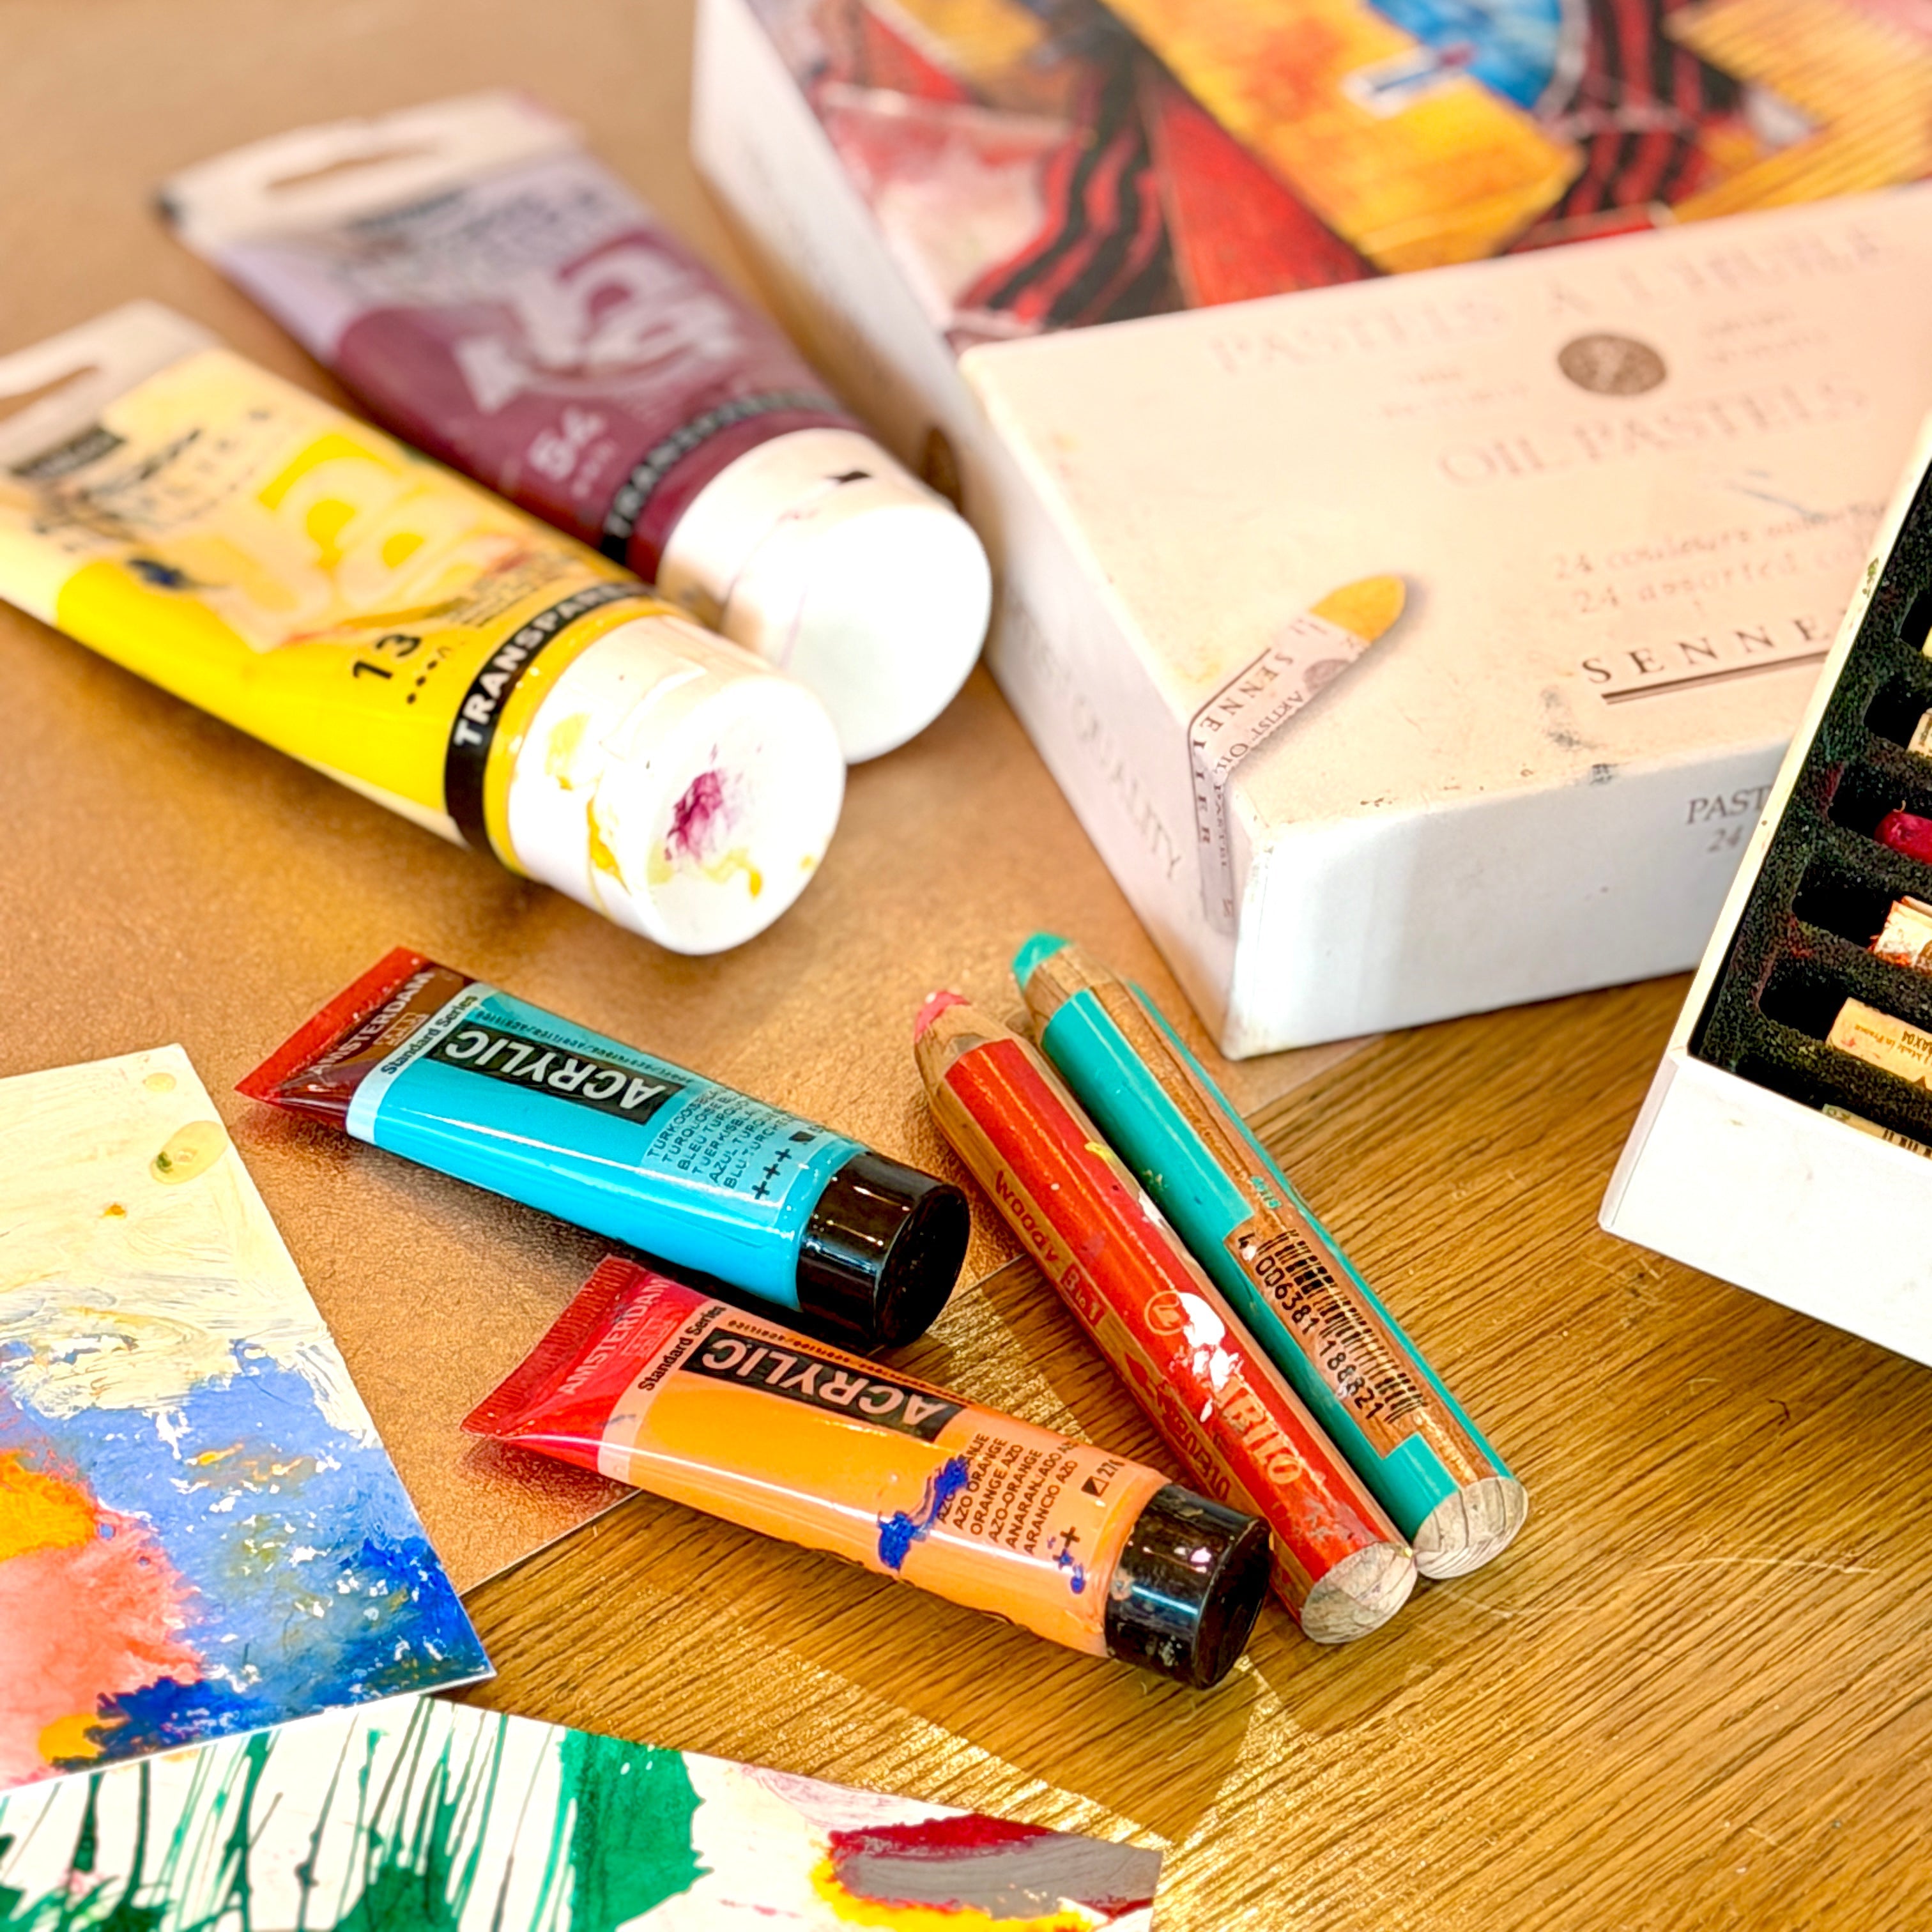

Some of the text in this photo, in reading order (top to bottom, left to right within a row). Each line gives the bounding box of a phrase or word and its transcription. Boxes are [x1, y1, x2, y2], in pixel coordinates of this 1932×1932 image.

[1571, 369, 1872, 464] PASTELS
[1571, 583, 1620, 615] 24
[351, 632, 422, 680] 13
[1581, 607, 1848, 684] SENNE
[310, 969, 437, 1077] AMSTERDAM
[381, 1025, 440, 1073] Standard
[434, 992, 478, 1030] Series
[445, 1029, 667, 1111] ACRYLIC
[676, 1133, 707, 1170] BLEU
[707, 1146, 737, 1183] AZUL
[723, 1159, 748, 1189] BLU
[1254, 1257, 1321, 1335] 006381
[637, 1333, 693, 1392] Standard
[685, 1301, 726, 1338] Series
[702, 1338, 955, 1427] ACRYLIC
[951, 1438, 1004, 1529] AZO ORANGE
[969, 1444, 1024, 1536] ORANGE AZO
[987, 1447, 1043, 1542] AZO-ORANGE
[1004, 1450, 1060, 1549] ANARANJADO
[1022, 1458, 1078, 1555] ARANCIO AZO
